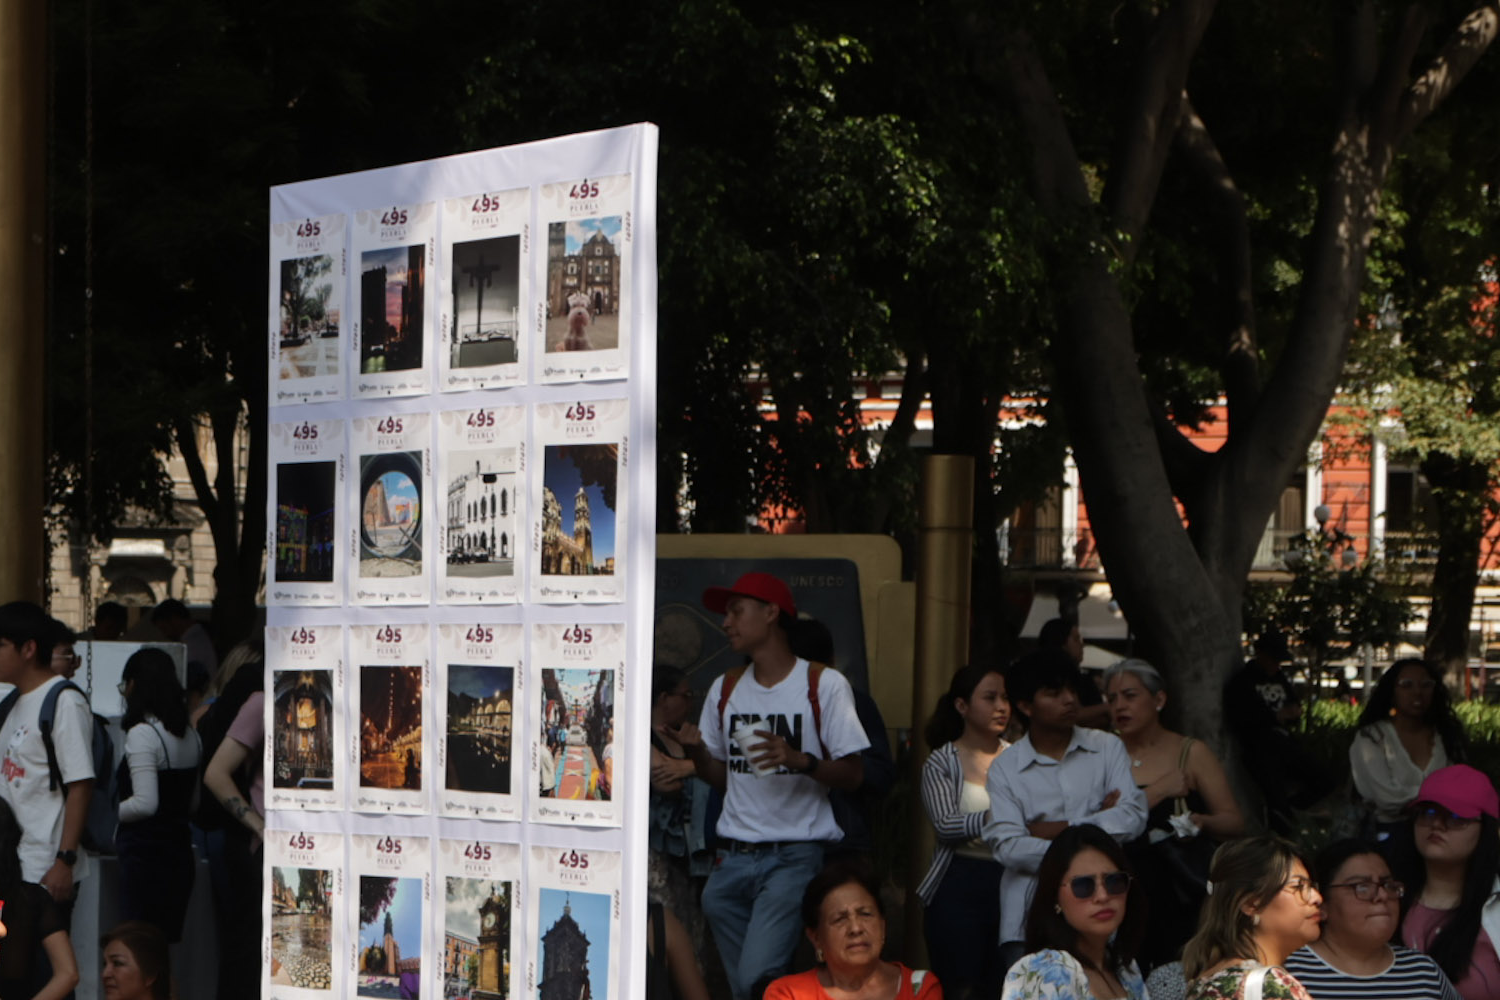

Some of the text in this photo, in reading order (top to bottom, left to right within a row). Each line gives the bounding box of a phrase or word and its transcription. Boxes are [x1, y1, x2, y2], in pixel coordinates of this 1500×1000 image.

[570, 182, 599, 199] 495
[472, 195, 499, 212] 495
[381, 209, 407, 225] 495
[297, 221, 320, 237] 495
[467, 411, 495, 427] 495
[565, 405, 595, 421] 495
[294, 424, 318, 439] 495
[377, 417, 403, 433] 495
[790, 576, 845, 588] UNESCO
[291, 629, 315, 644] 495
[376, 628, 401, 642] 495
[466, 627, 493, 642] 495
[562, 627, 592, 643] 495
[289, 835, 314, 850] 495
[377, 839, 401, 854] 495
[464, 844, 491, 860] 495
[559, 852, 588, 869] 495
